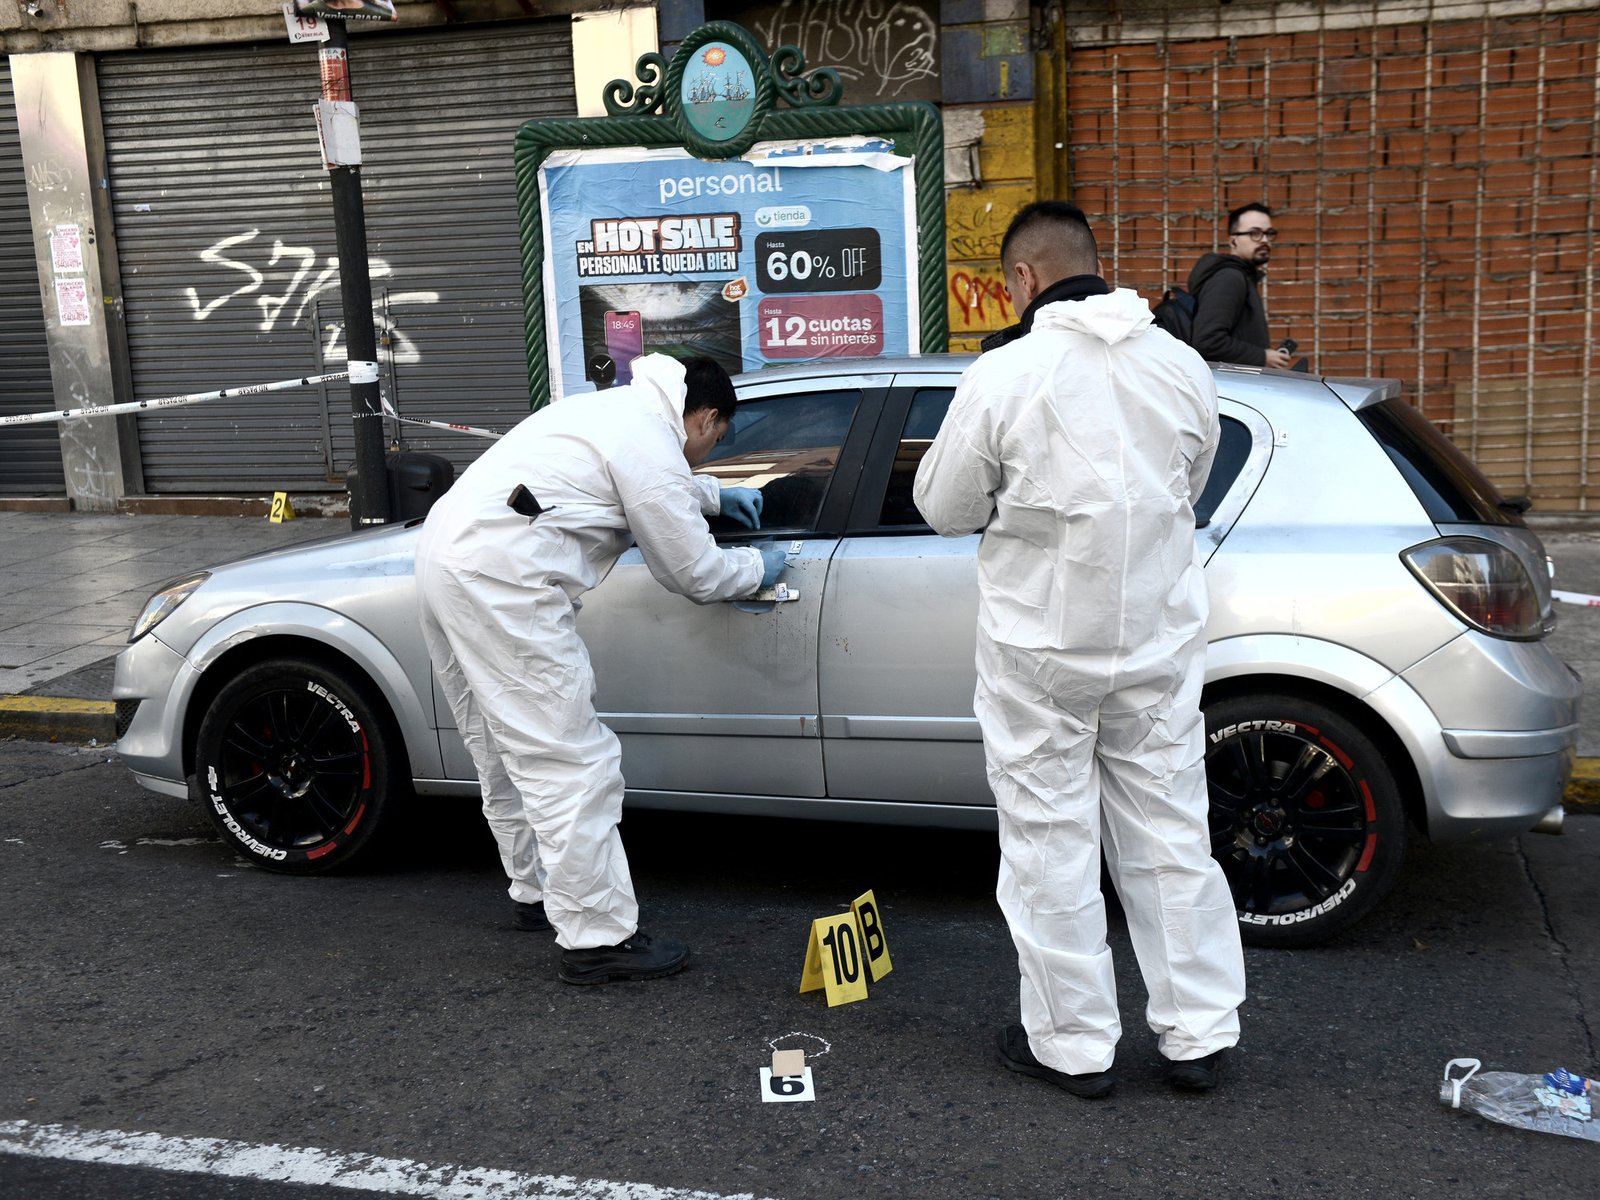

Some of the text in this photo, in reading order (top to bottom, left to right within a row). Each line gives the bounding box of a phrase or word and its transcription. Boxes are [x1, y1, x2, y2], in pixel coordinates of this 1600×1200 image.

[659, 165, 783, 204] personal
[773, 210, 806, 221] tienda
[577, 216, 736, 254] EN HOT SALE
[579, 251, 737, 276] PERSONAL TE QUEDA BIEN
[766, 247, 867, 281] 60% OFF
[611, 320, 635, 330] 18:45
[765, 316, 808, 347] 12
[808, 316, 872, 333] cuotas
[810, 331, 877, 346] sin interés
[272, 497, 283, 519] 2
[306, 681, 360, 734] VECTRA
[1209, 720, 1296, 744] VECTRA
[210, 793, 288, 861] CHEVROLET
[1238, 877, 1357, 926] CHEVROLET
[858, 901, 885, 963] B
[822, 922, 860, 986] 10
[769, 1074, 805, 1096] 6
